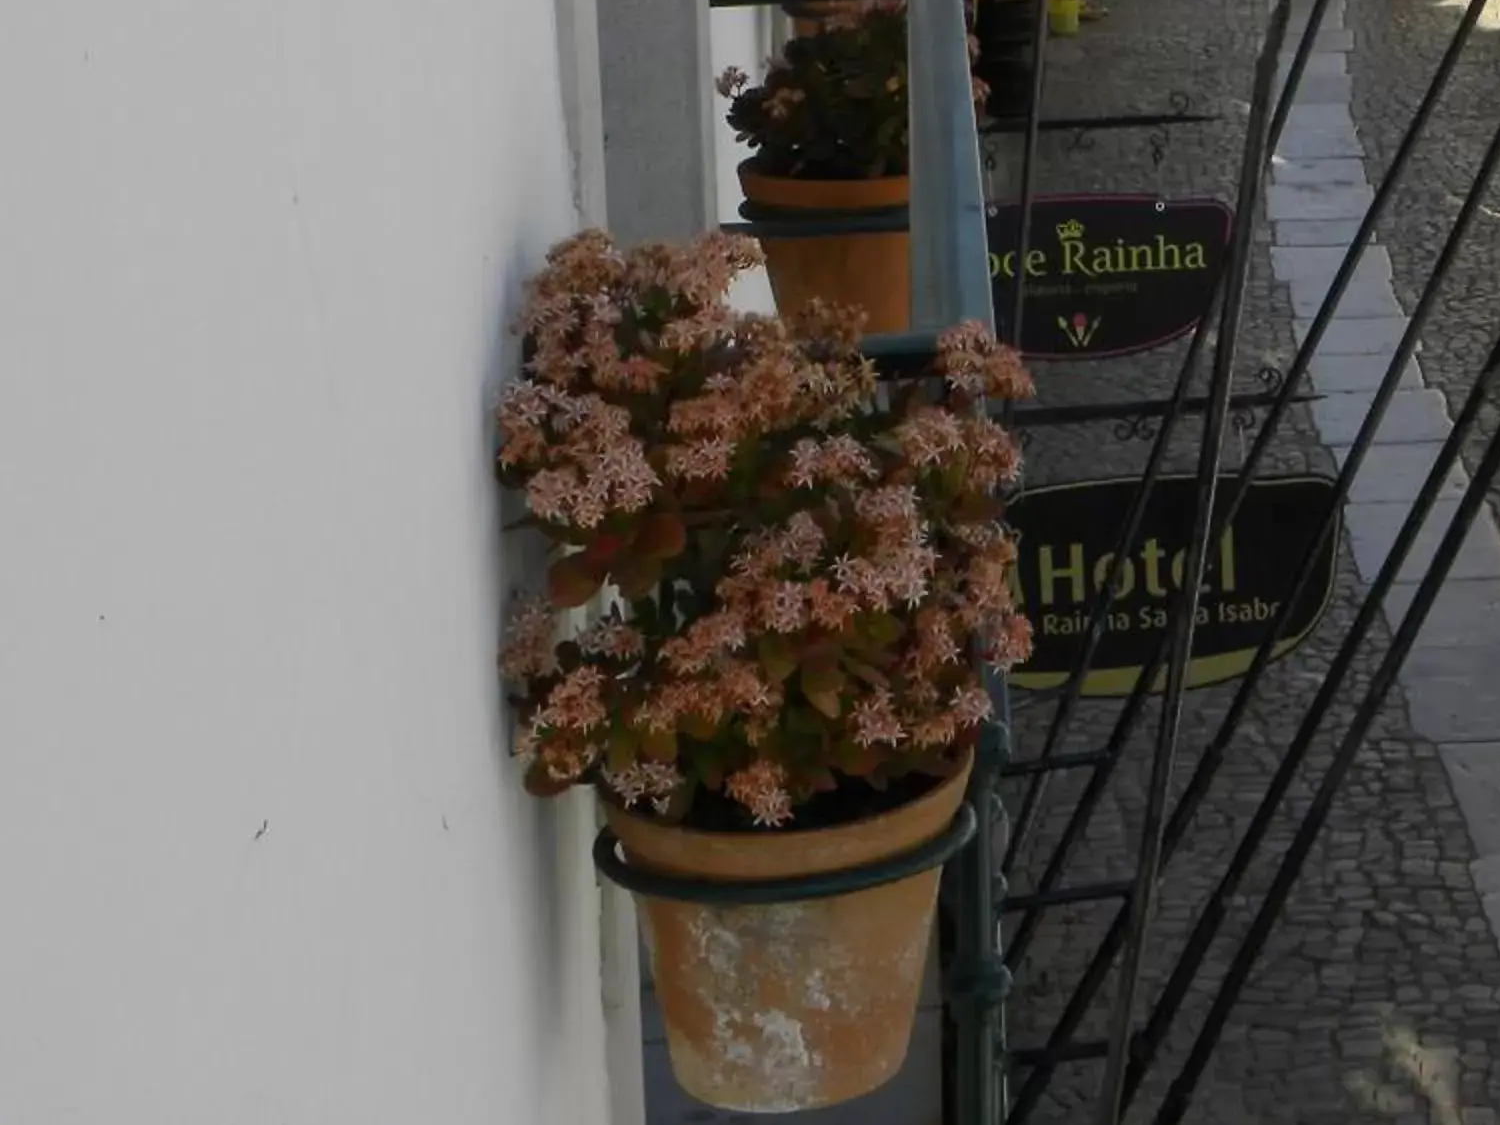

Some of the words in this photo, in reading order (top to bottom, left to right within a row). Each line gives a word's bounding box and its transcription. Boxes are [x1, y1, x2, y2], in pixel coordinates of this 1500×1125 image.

[988, 249, 1047, 278] oce
[1061, 234, 1208, 279] Rainha
[1139, 604, 1209, 630] Saa
